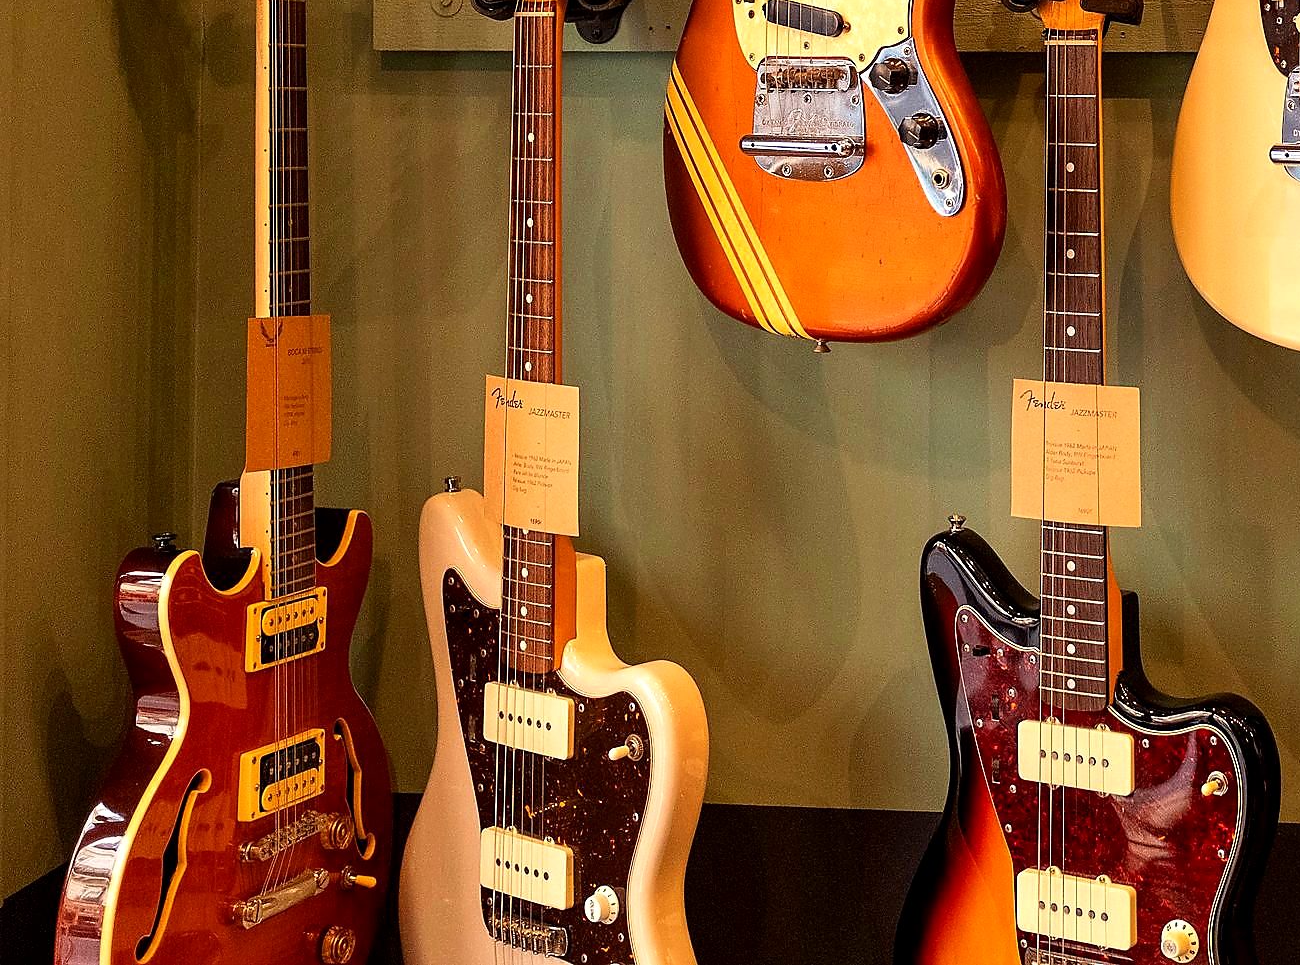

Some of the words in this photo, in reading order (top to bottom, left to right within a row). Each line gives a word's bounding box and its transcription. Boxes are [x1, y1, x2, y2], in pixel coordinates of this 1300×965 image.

[491, 387, 524, 409] Fender
[528, 407, 571, 420] JAZZMASTER
[1020, 389, 1066, 411] Fender
[1070, 409, 1117, 419] JAZZMASTER
